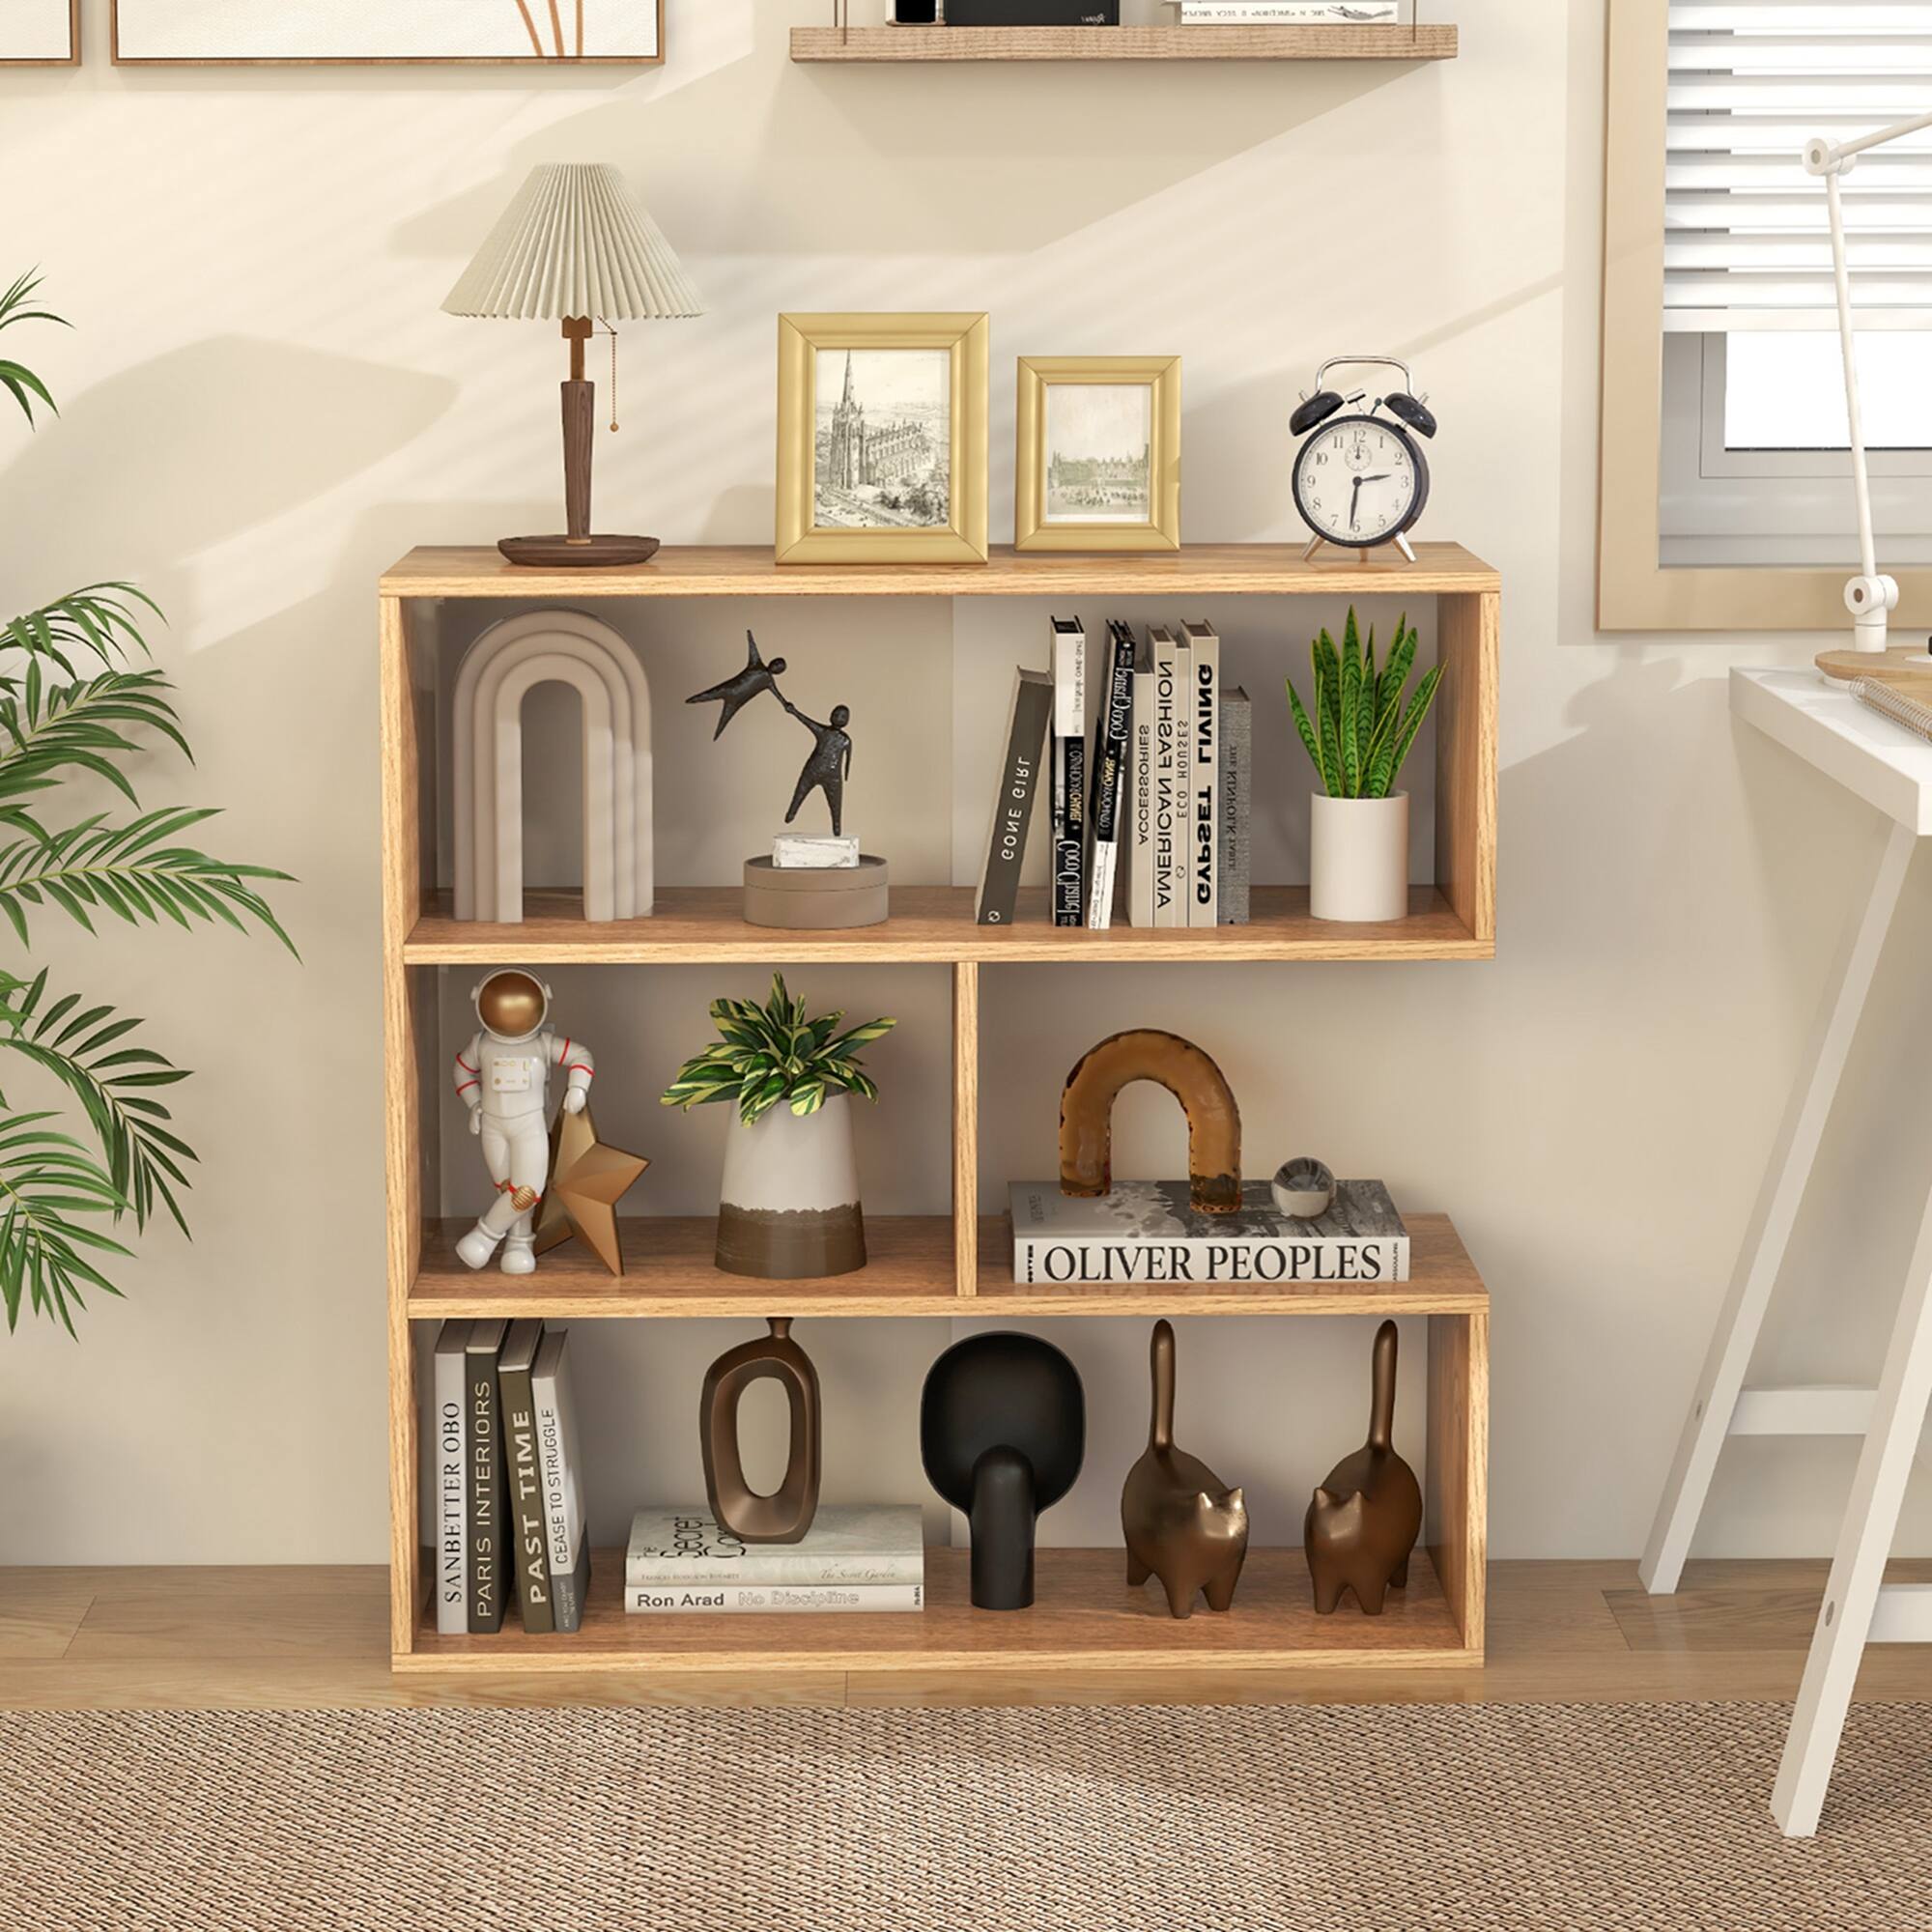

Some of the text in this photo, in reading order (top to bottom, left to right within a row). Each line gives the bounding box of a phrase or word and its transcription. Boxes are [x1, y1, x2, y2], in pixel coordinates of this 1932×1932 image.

[1334, 436, 1344, 448] 11
[1353, 430, 1366, 443] 12
[1379, 436, 1383, 448] 1
[1316, 452, 1328, 466] 10
[1395, 453, 1403, 466] 2
[1307, 475, 1316, 488] 9
[1401, 475, 1408, 488] 3
[1313, 497, 1321, 510] 8
[1330, 514, 1339, 526] 7
[1352, 520, 1361, 533] 6
[1378, 514, 1386, 526] 5
[1044, 1246, 1194, 1281] OLIVER
[1207, 1244, 1381, 1281] PEOPLES
[541, 1408, 568, 1565] CEASE TO STRUGGLE
[442, 1403, 463, 1603] SANBETTER OBO
[474, 1381, 493, 1617] PARIS INTERIORS
[513, 1410, 547, 1605] PAST TIME
[638, 1593, 724, 1607] Ron Arad
[738, 1590, 860, 1608] No Discipline
